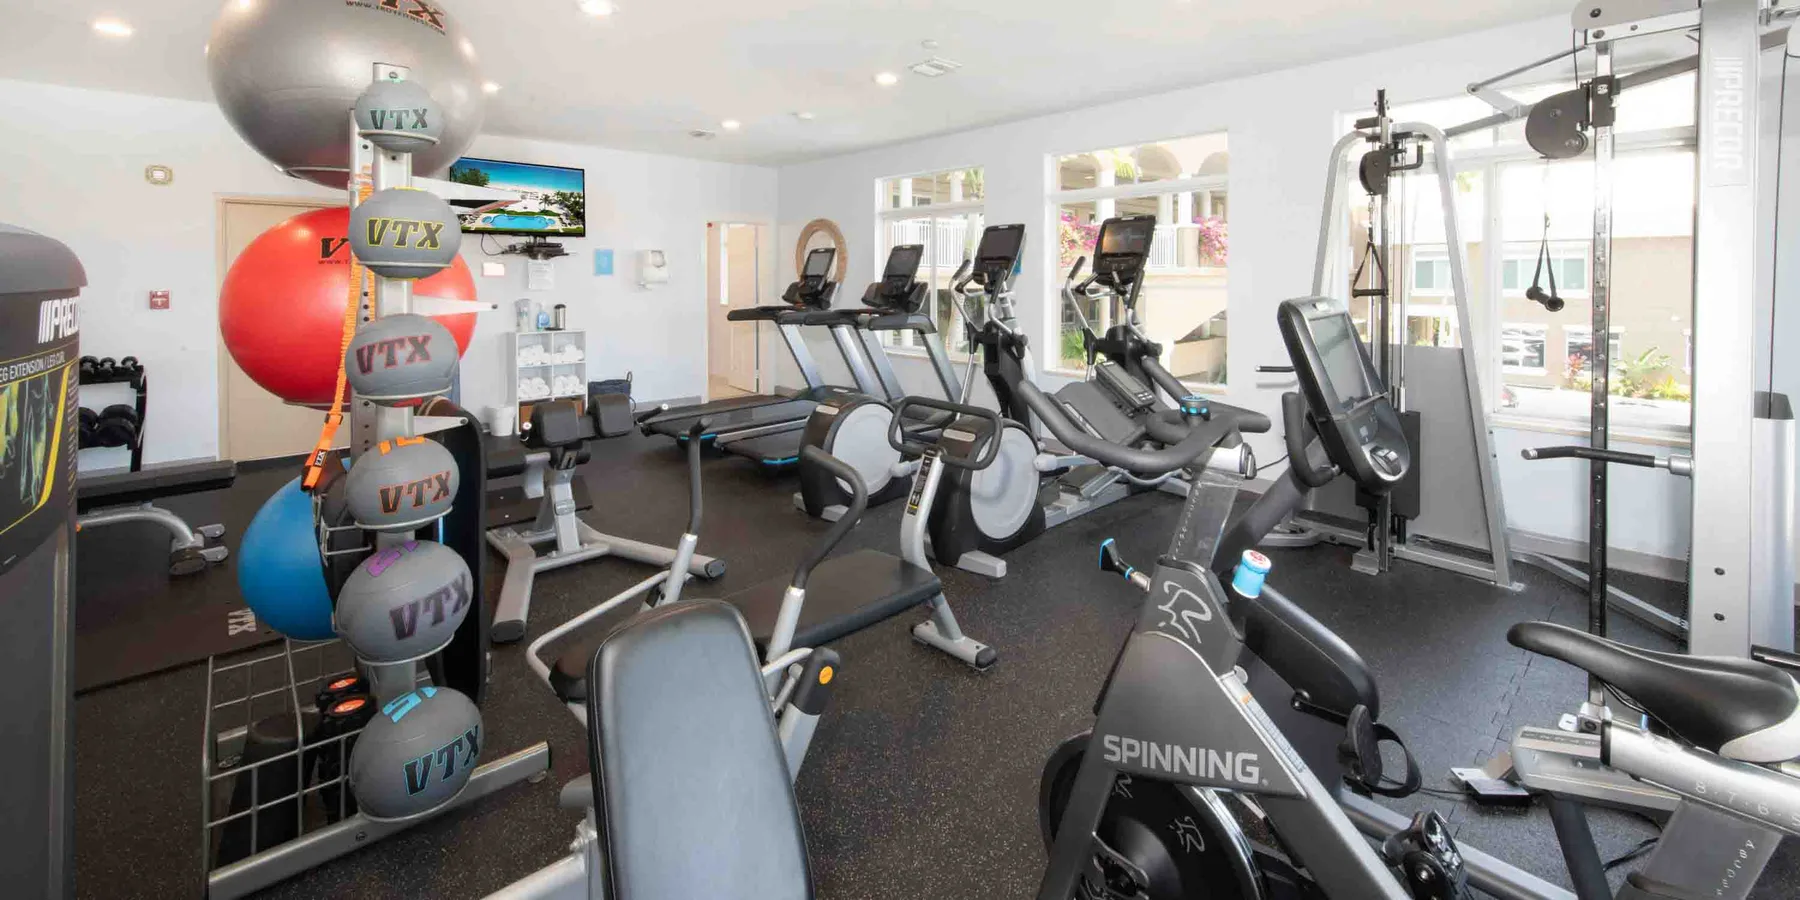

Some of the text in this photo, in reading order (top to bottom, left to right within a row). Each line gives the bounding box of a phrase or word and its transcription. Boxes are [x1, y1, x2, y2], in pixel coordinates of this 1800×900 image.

[369, 108, 428, 130] VTX
[366, 217, 443, 249] VTX
[9, 358, 44, 380] EXTENSION
[356, 333, 433, 375] VTX
[379, 470, 450, 514] VTX
[389, 569, 470, 641] VTX
[404, 724, 480, 797] VTX
[1103, 734, 1260, 785] SPINNING
